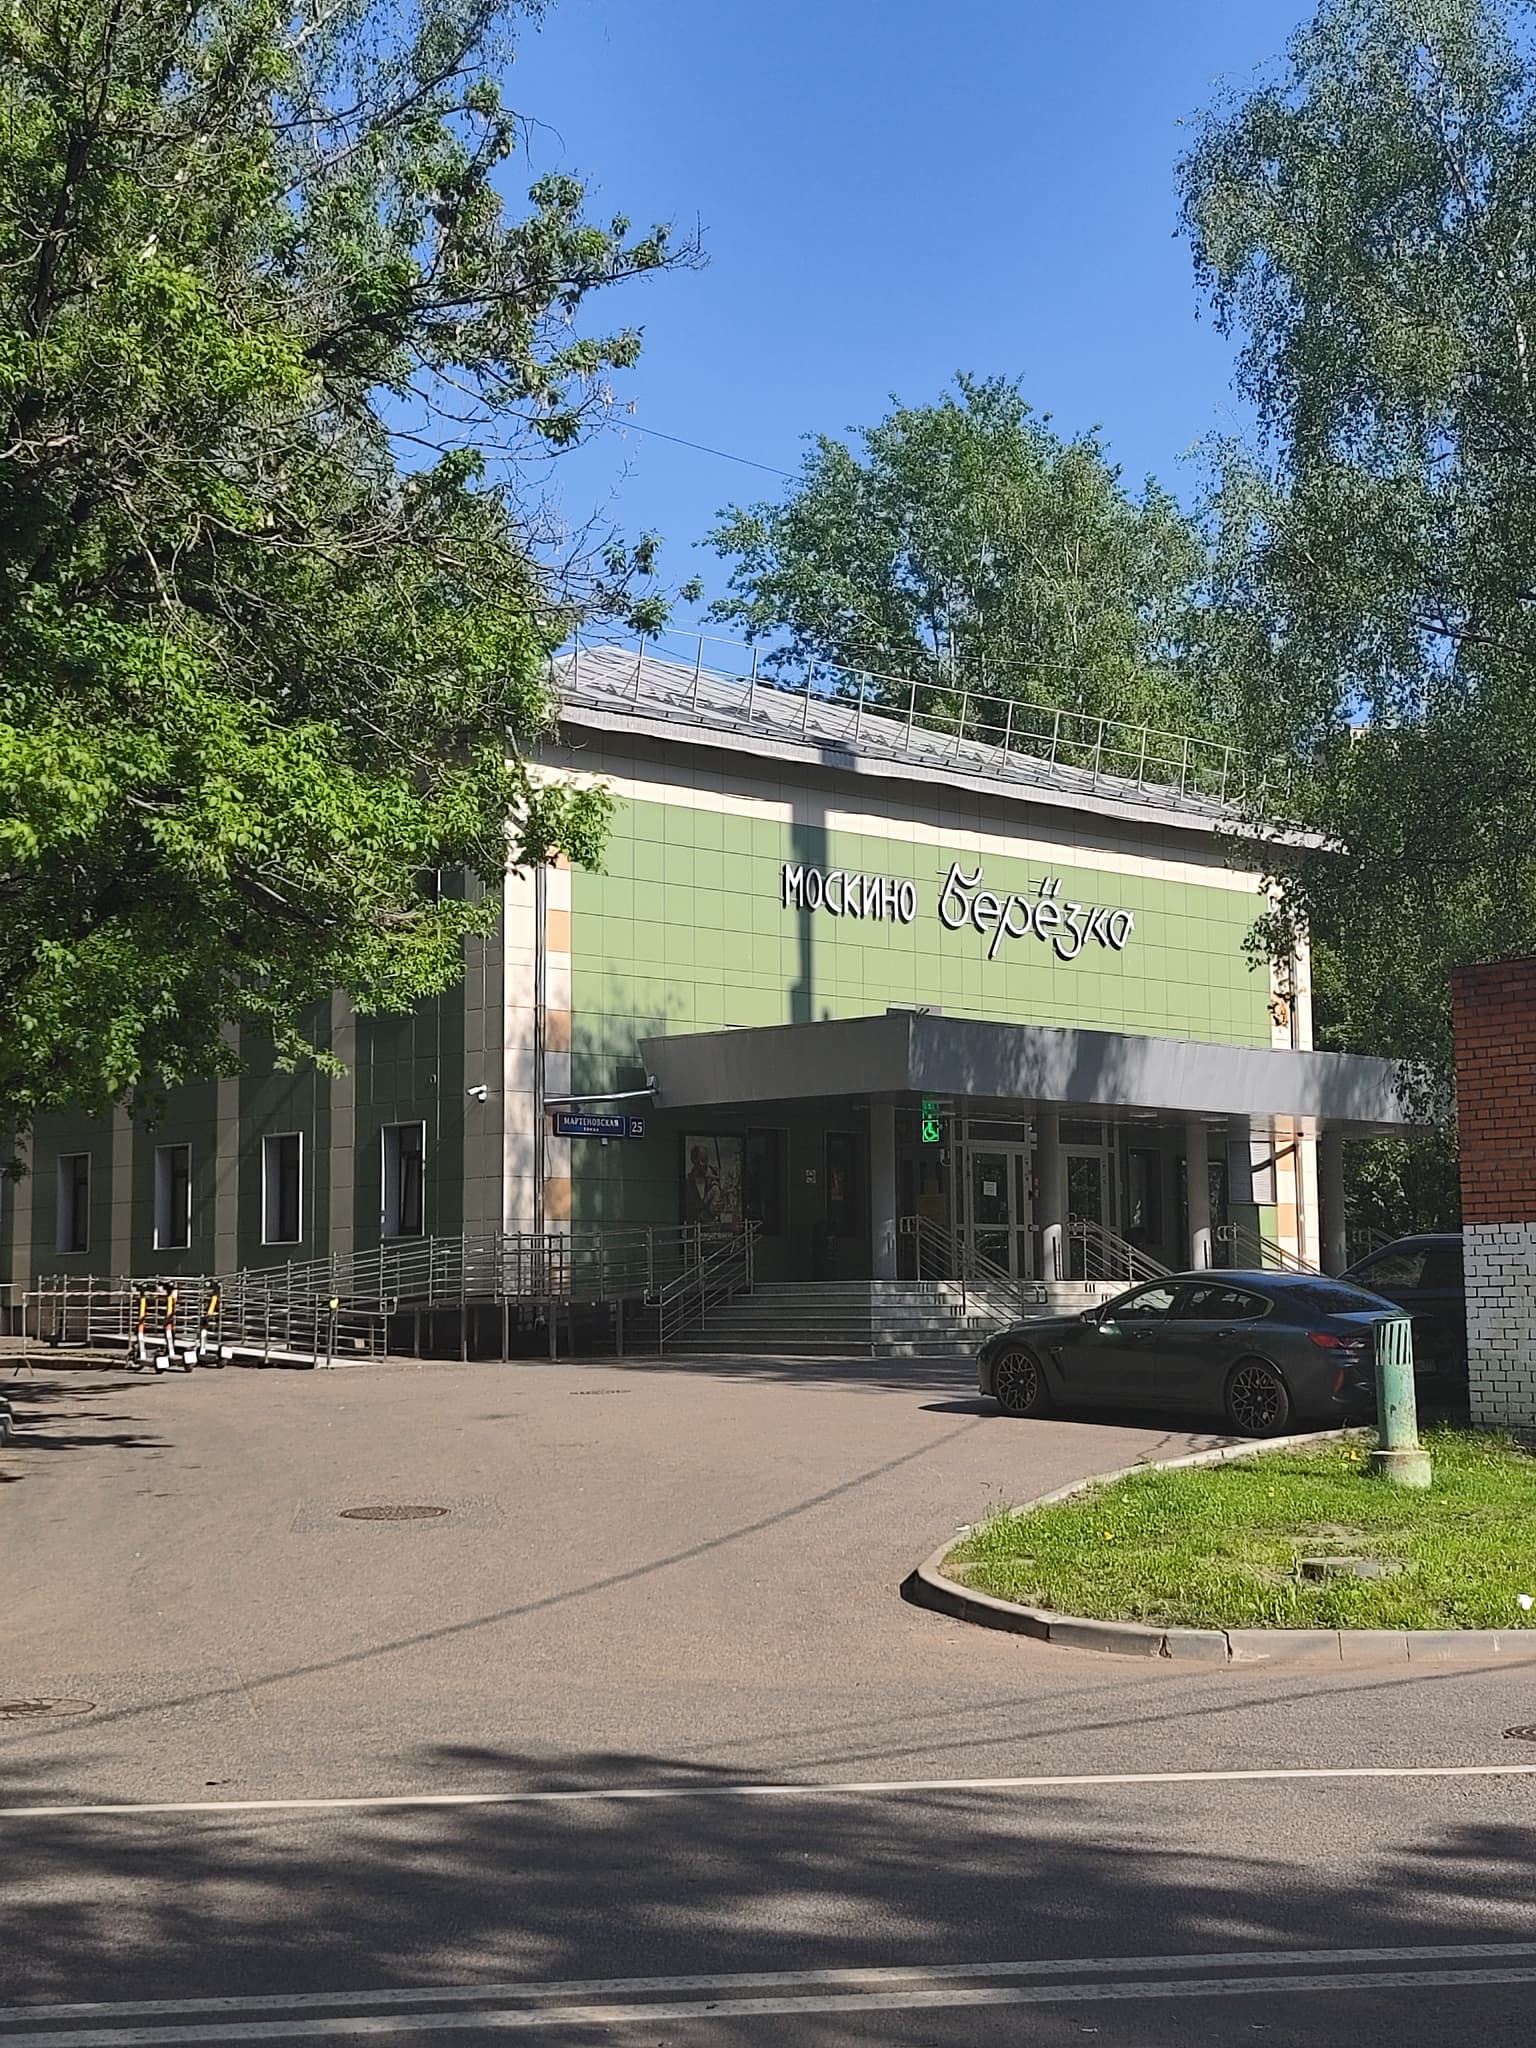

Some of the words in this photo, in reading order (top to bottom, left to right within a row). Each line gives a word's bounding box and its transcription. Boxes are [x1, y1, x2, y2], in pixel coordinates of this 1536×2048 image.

[782, 863, 917, 924] МОСКИНО
[563, 1116, 619, 1127] МАРТЕНОВСКАЯ
[631, 1121, 643, 1133] 25
